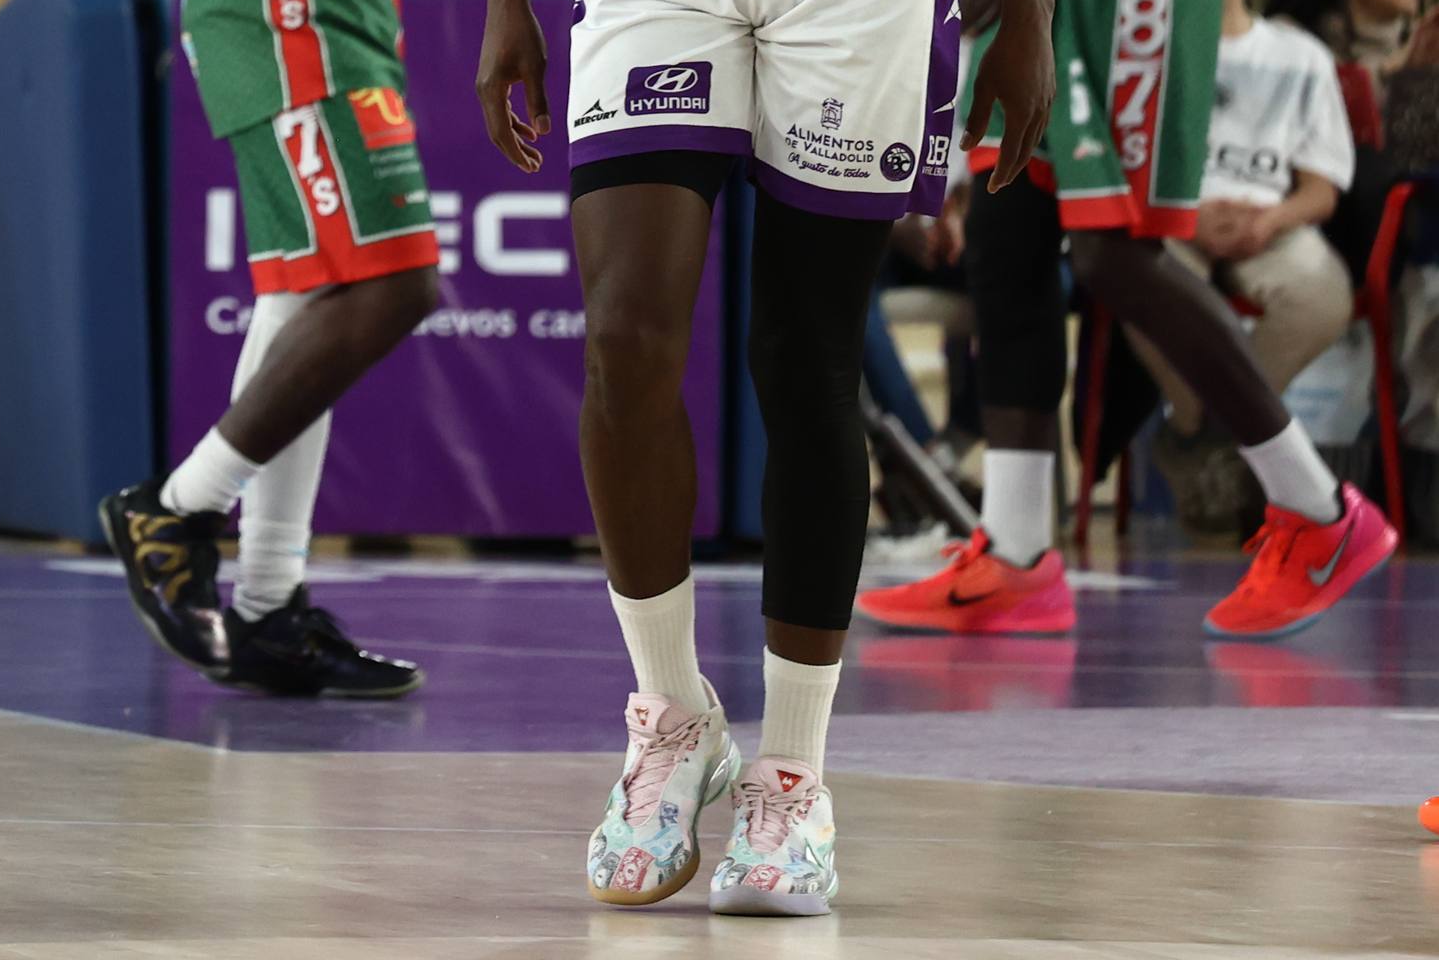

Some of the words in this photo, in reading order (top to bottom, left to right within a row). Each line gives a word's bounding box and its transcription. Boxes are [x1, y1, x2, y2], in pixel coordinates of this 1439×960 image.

[630, 97, 706, 112] HYUNDAI
[574, 109, 618, 128] MERCURY
[787, 123, 875, 151] ALIMENTOS
[785, 137, 798, 149] DE
[804, 141, 874, 163] VALLADOLID
[799, 160, 829, 174] gusto
[827, 166, 842, 177] de
[843, 168, 871, 178] todos
